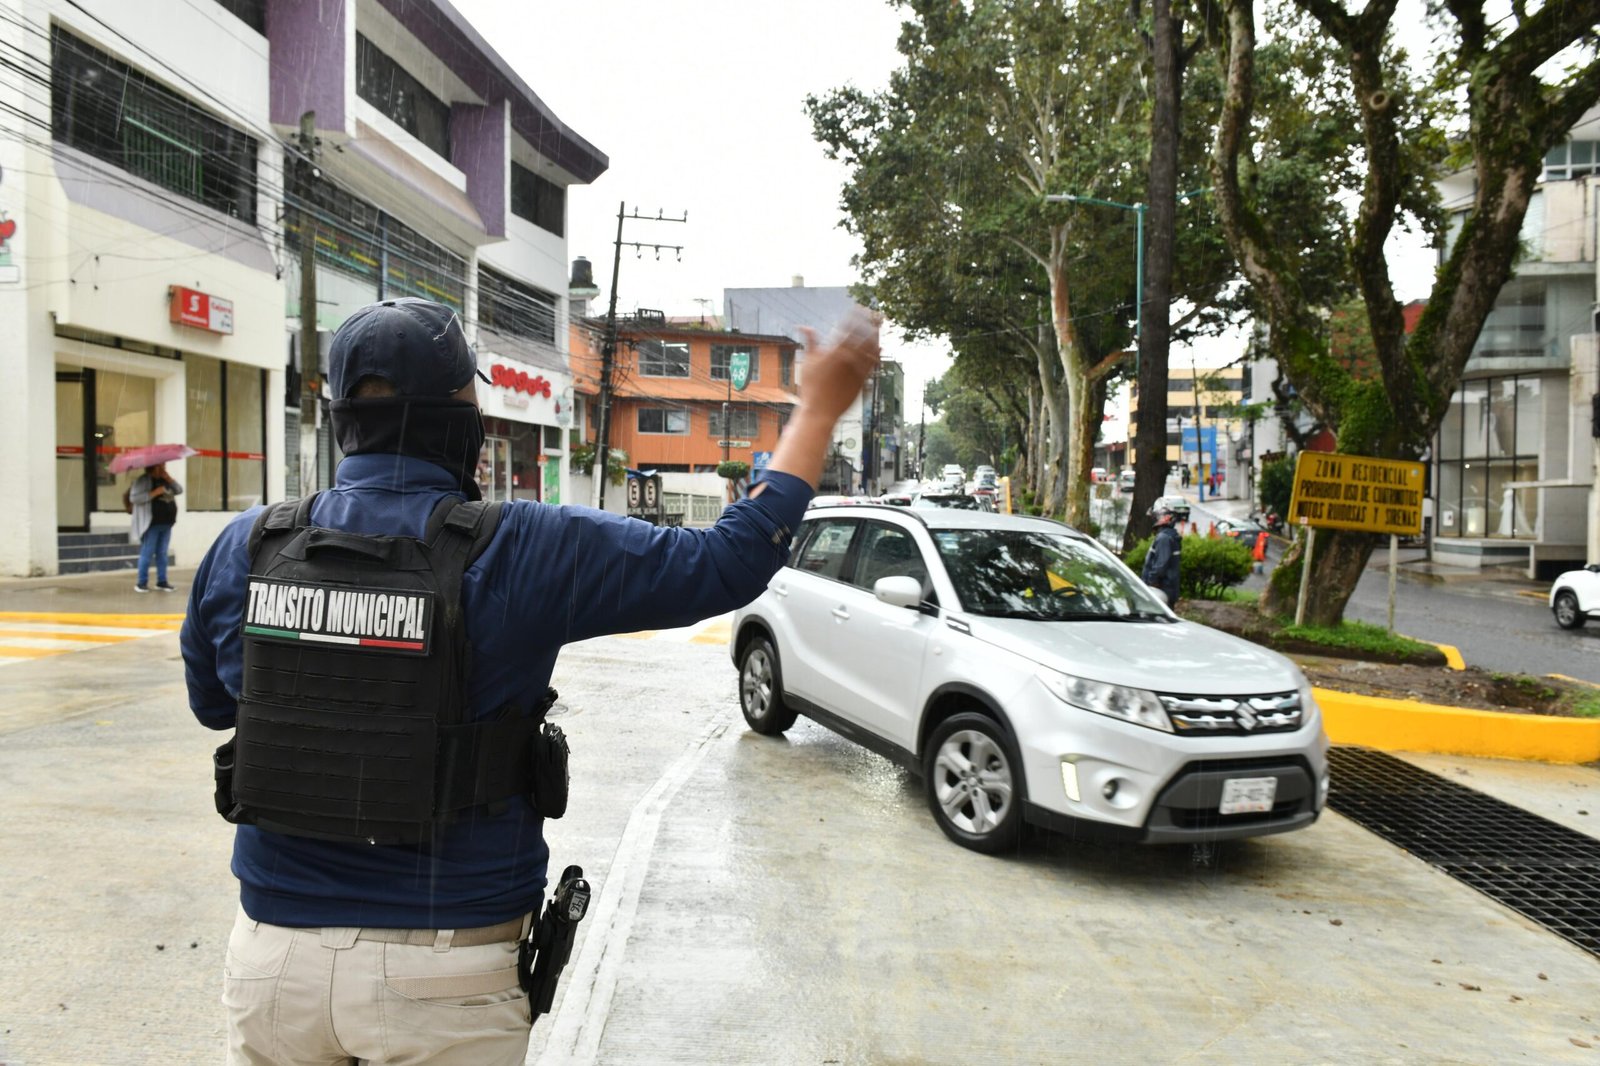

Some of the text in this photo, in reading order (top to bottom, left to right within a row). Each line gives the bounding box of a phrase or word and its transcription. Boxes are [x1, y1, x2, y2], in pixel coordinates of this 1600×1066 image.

[732, 367, 746, 381] 48
[1315, 459, 1408, 486] ZONA RESIDENCIAL
[1300, 479, 1343, 500] PROHIBIDO
[1343, 484, 1359, 501] USO
[1360, 485, 1370, 503] DE
[1296, 500, 1418, 528] MOTOS RUIDOSAS Y SIRENAS
[246, 582, 425, 639] TRANSITO MUNICIPAL
